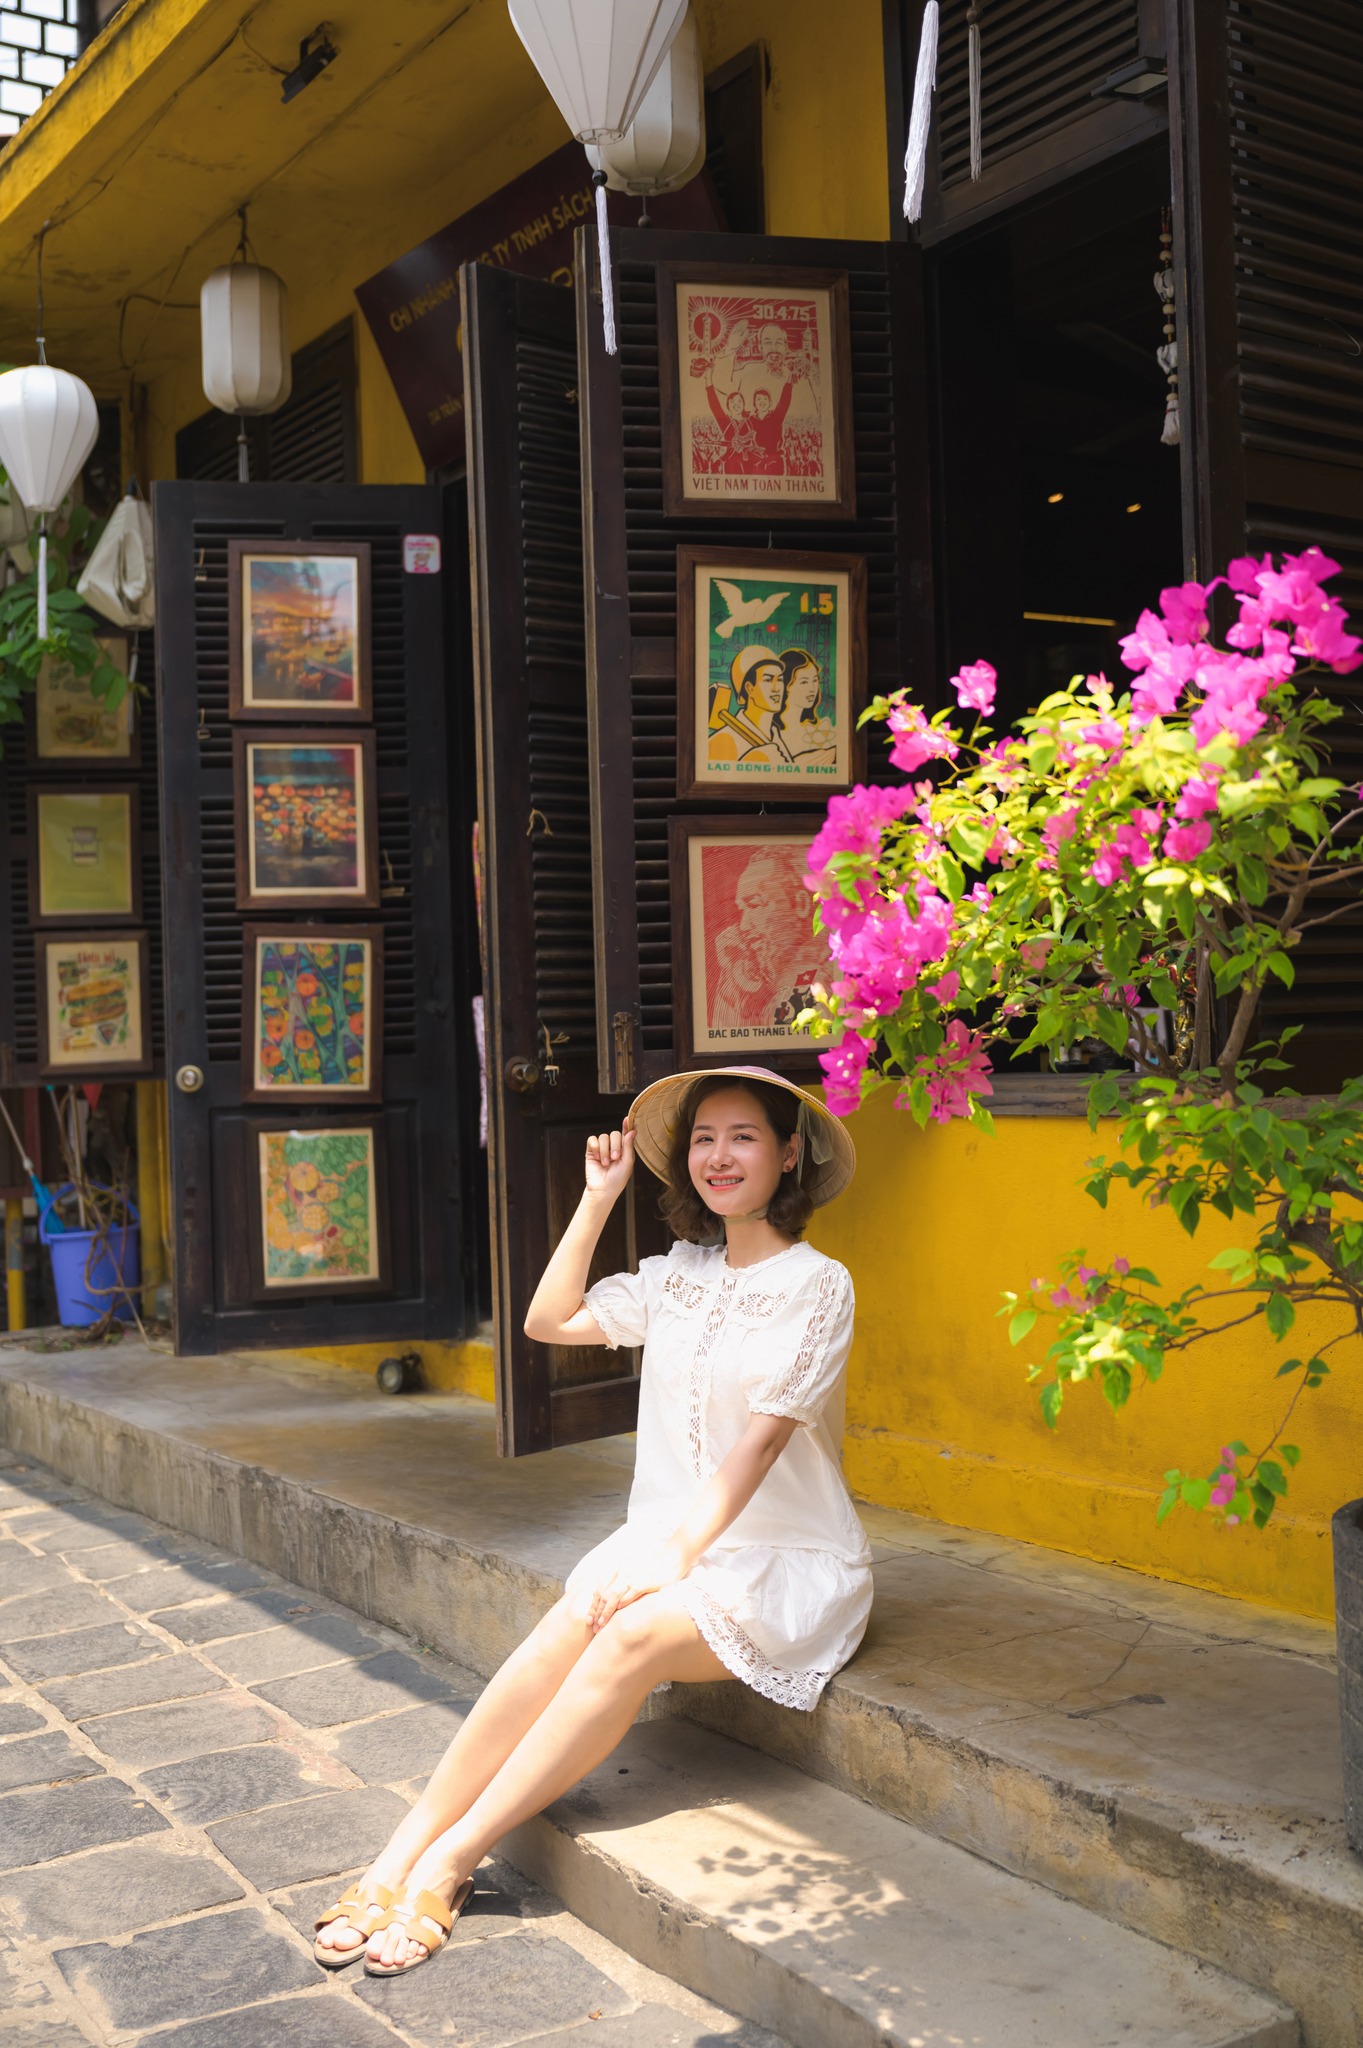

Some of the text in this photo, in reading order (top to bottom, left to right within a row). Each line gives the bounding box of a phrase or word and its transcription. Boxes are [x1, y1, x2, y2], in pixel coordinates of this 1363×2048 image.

[389, 305, 413, 332] CHI
[492, 238, 511, 266] TY
[511, 214, 554, 254] TNHH
[551, 186, 596, 230] SÁCH
[752, 304, 810, 322] 30.4.75
[724, 478, 749, 491] NAM
[800, 592, 834, 616] 1.5
[707, 762, 731, 771] LAO
